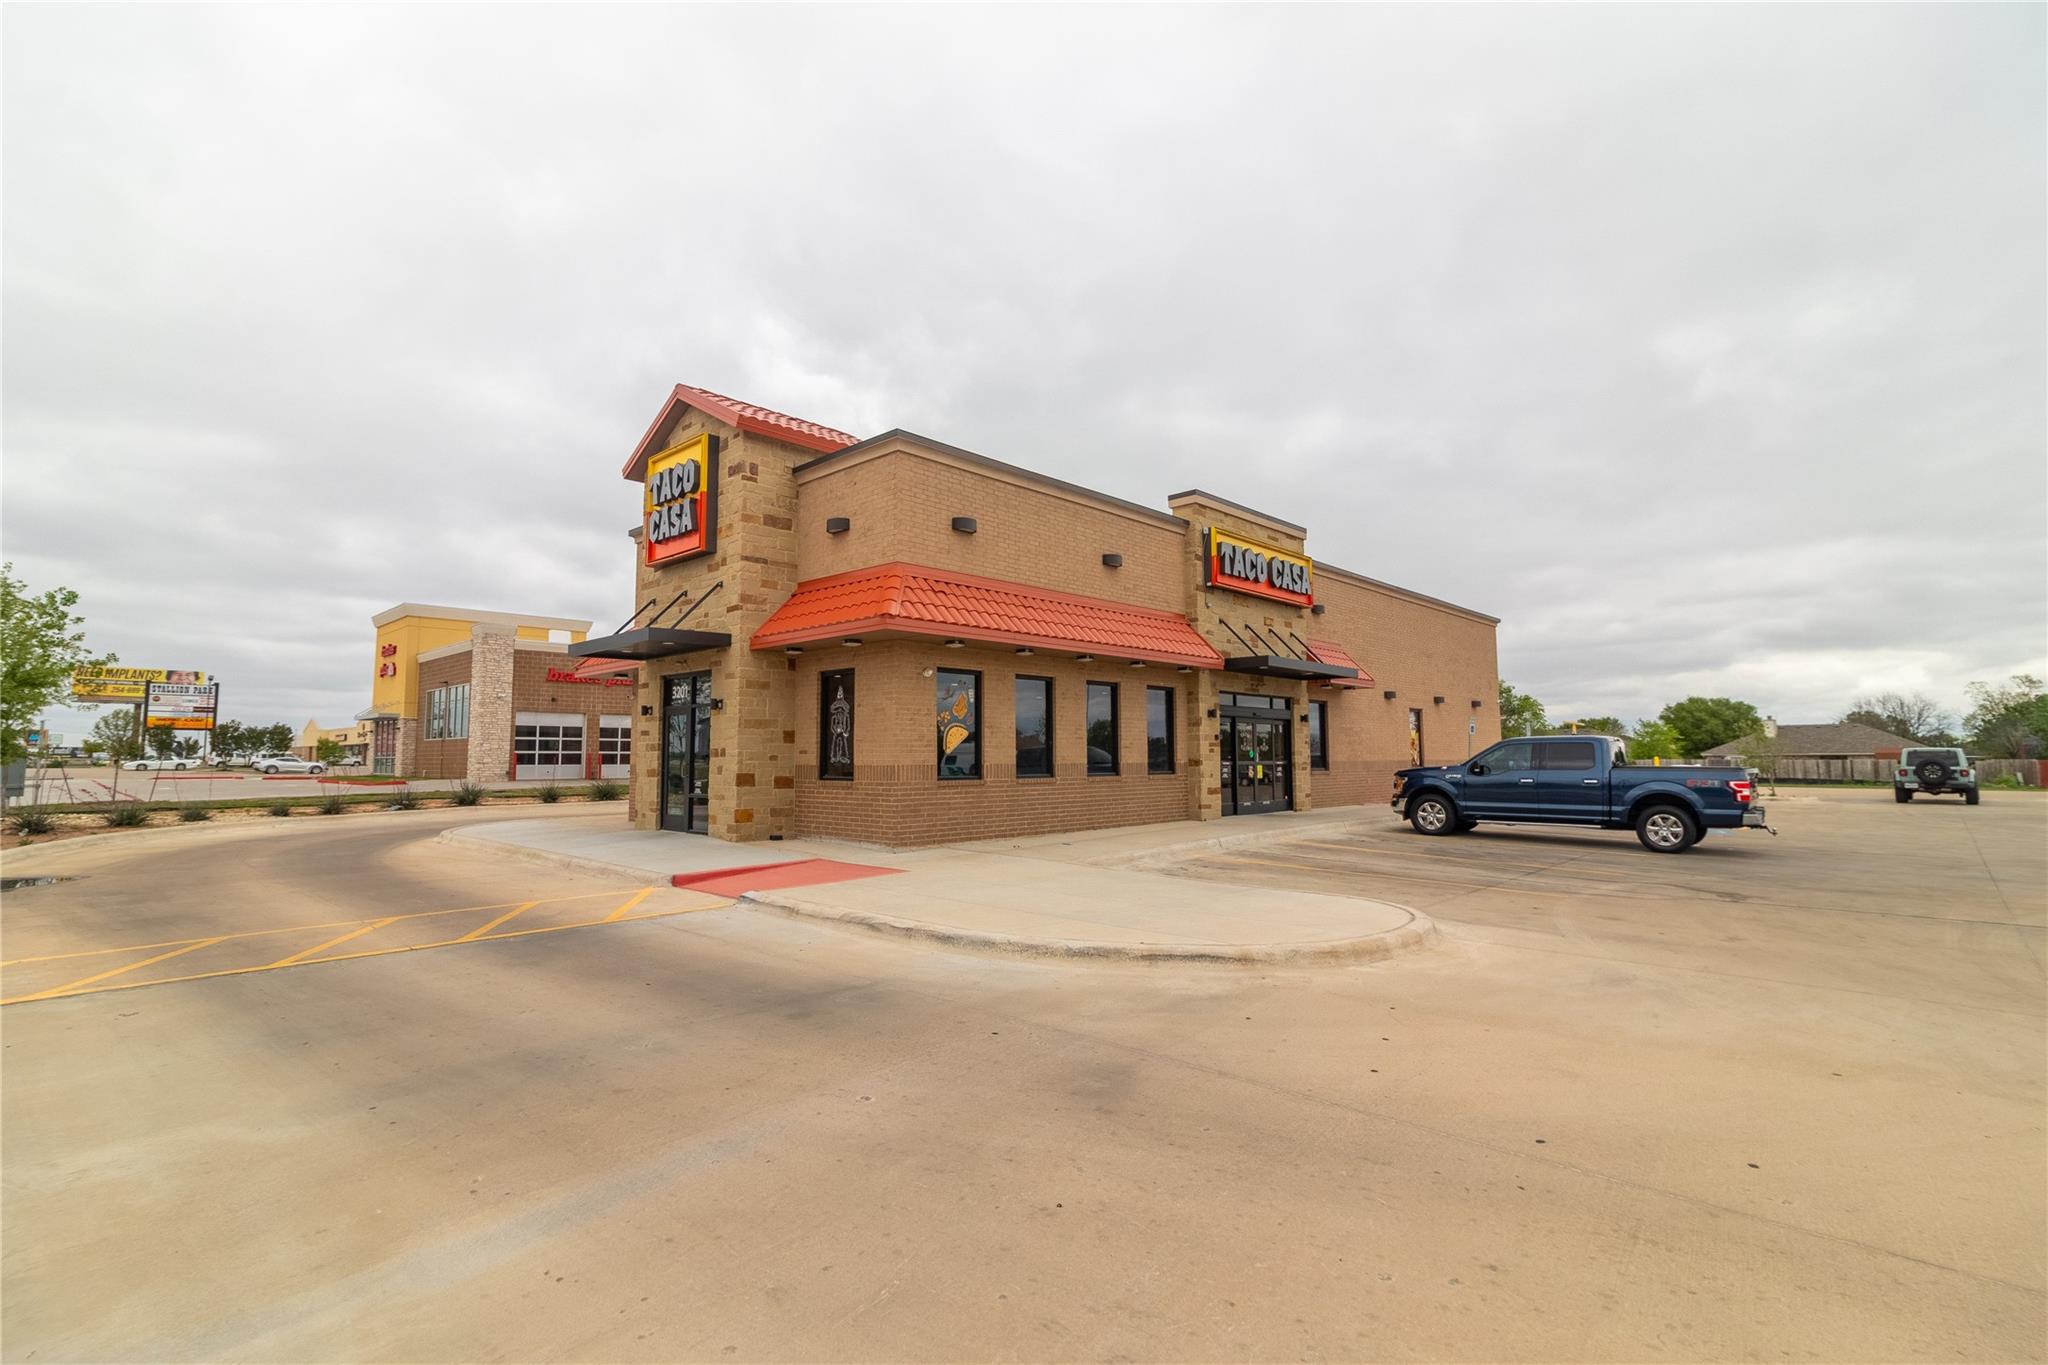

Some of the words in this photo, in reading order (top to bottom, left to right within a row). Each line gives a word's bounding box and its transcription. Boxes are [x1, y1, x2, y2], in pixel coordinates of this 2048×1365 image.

[649, 458, 698, 506] TACO
[649, 498, 696, 544] CASA
[1218, 541, 1267, 583] TACO
[1268, 556, 1312, 595] CASA
[104, 668, 162, 680] IMPLANTS?
[151, 684, 190, 694] STALLION
[672, 686, 688, 699] 3201
